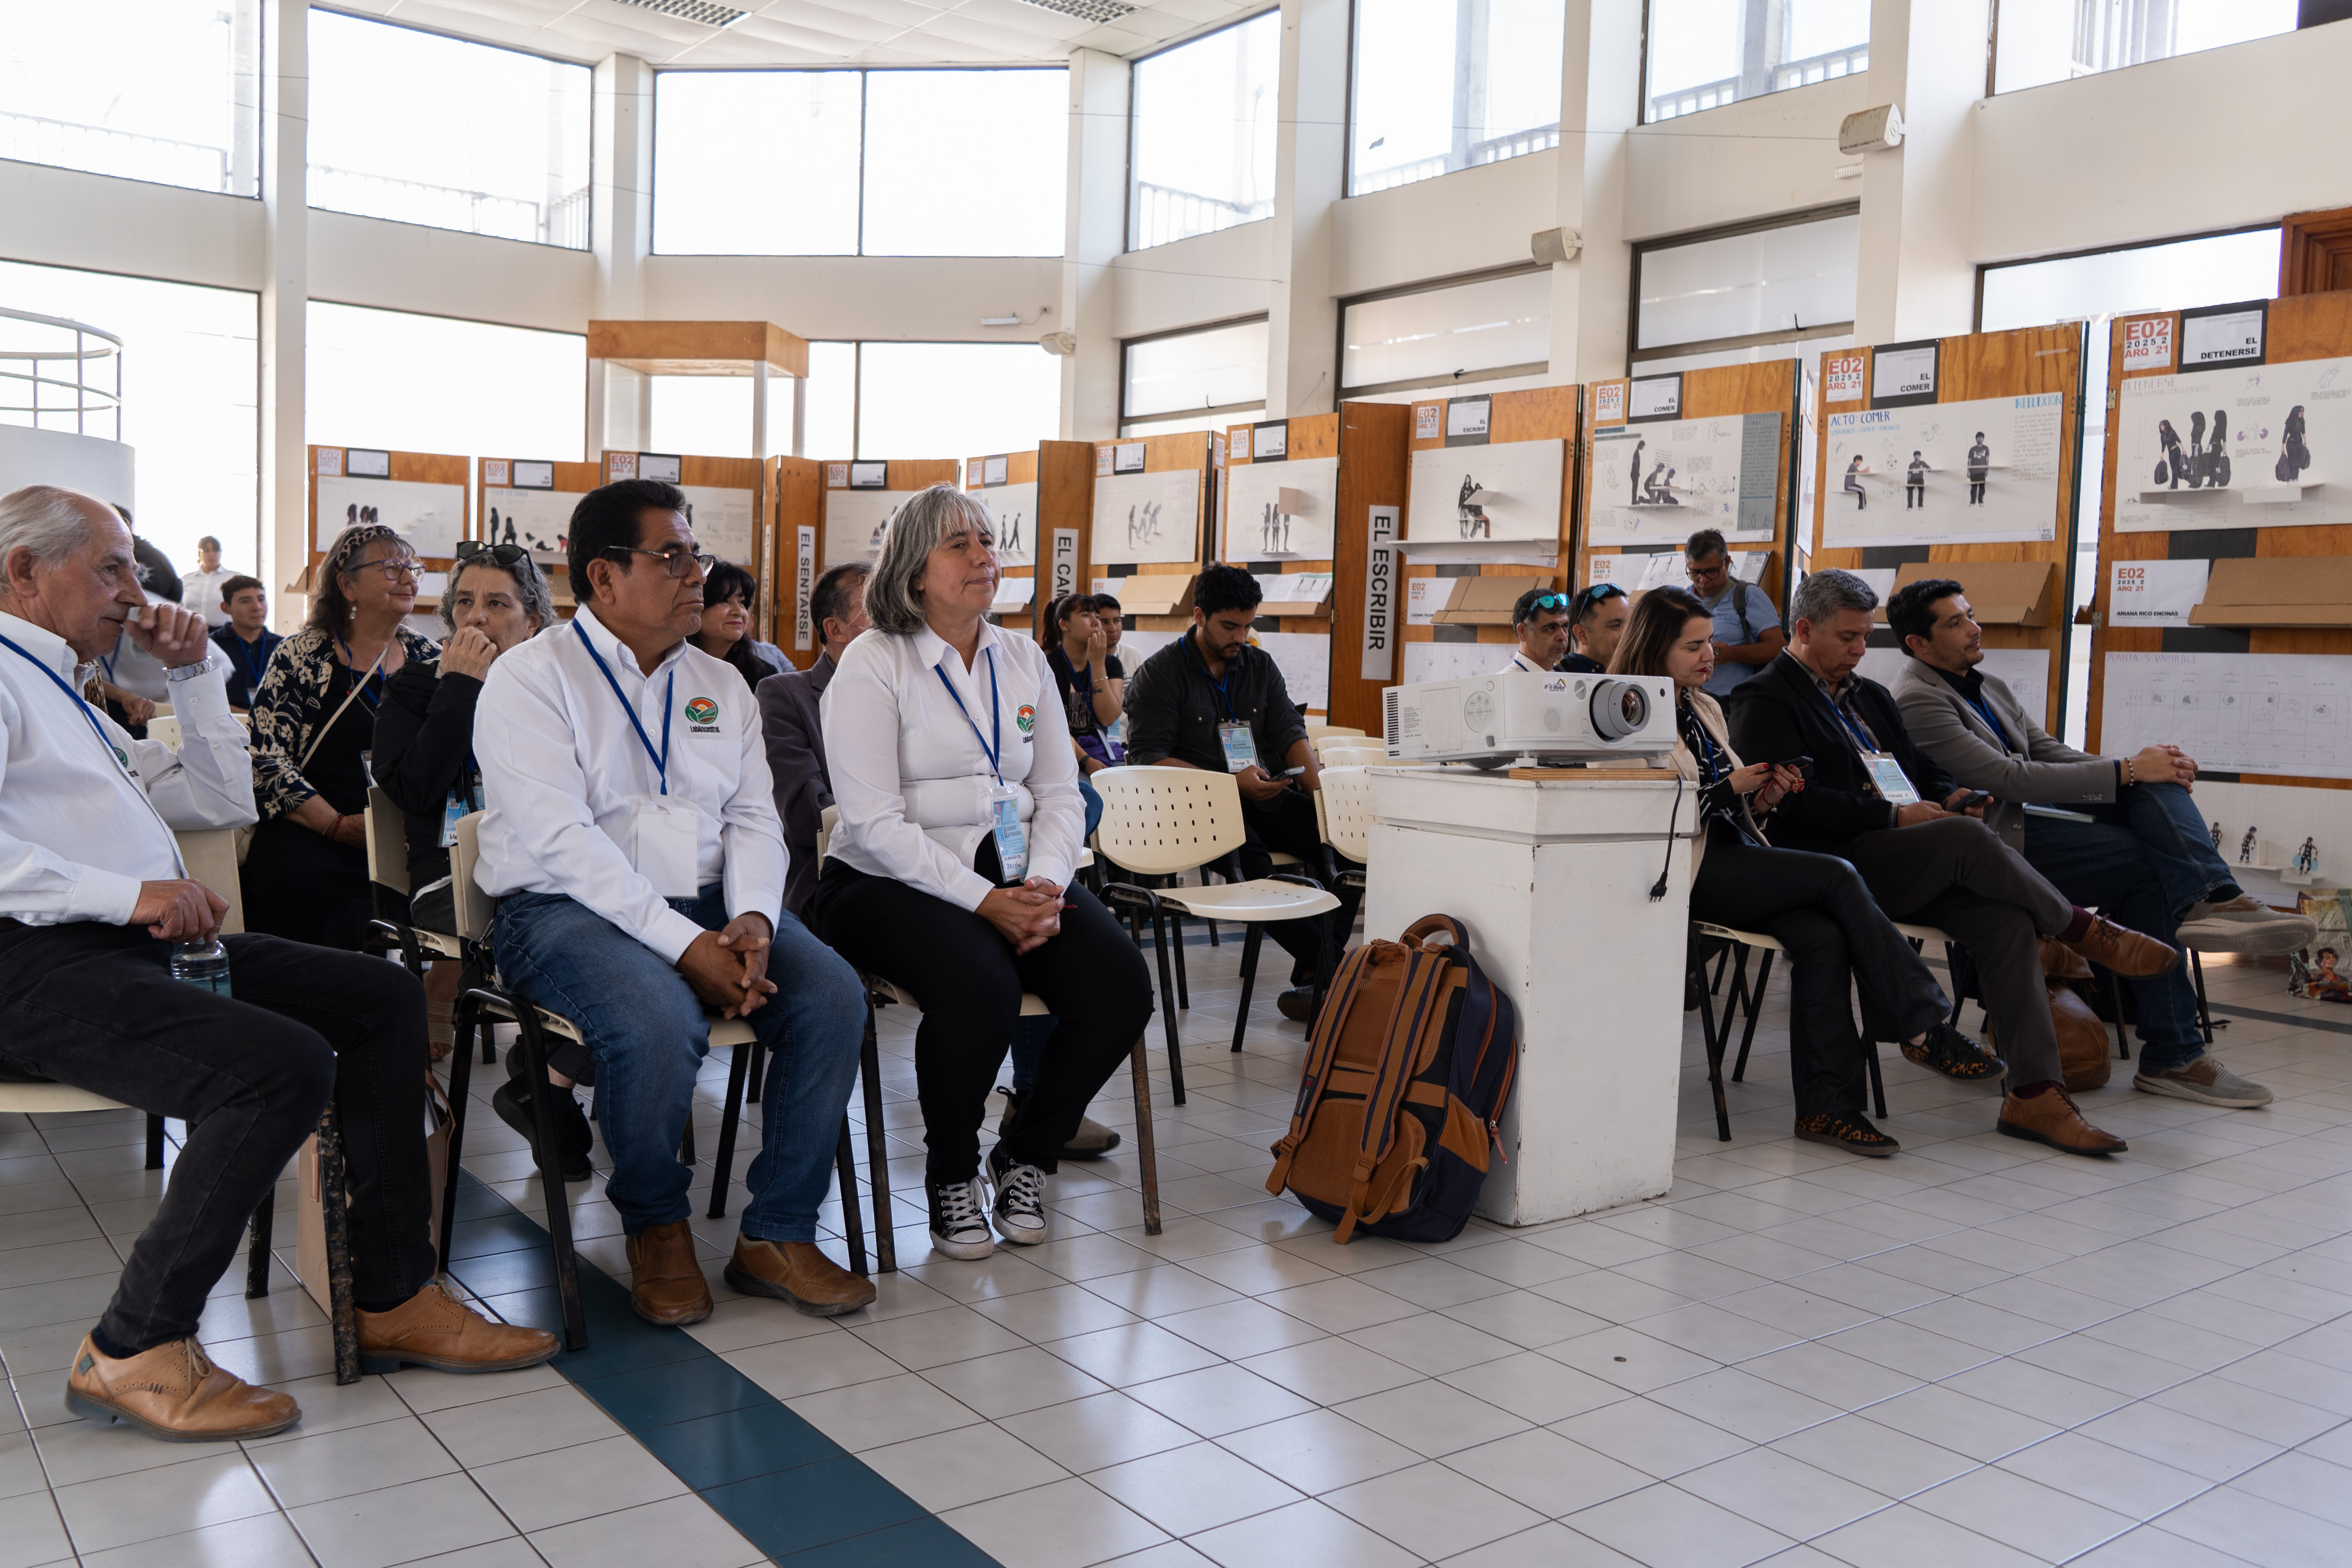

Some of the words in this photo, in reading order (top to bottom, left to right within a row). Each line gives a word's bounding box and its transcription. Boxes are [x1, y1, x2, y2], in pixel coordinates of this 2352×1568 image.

[2126, 319, 2169, 341] E02
[2127, 338, 2156, 348] 2025
[2125, 348, 2149, 358] ARQ
[2156, 344, 2168, 355] 21
[2201, 347, 2257, 359] DETENERSE
[1829, 358, 1862, 375] E02
[1827, 382, 1846, 390] ARQ
[1900, 383, 1930, 392] COMER
[1599, 386, 1621, 399] E02
[1419, 408, 1437, 419] E02
[1861, 411, 1890, 423] COMER
[1232, 432, 1247, 441] E02
[1098, 448, 1114, 458] E02
[612, 455, 634, 464] E02
[1375, 516, 1390, 542] EL
[801, 533, 810, 552] EL
[1058, 537, 1071, 558] EL
[1594, 560, 1611, 569] E02
[2118, 568, 2145, 578] E02
[798, 557, 810, 641] SENTARSE
[1368, 549, 1389, 651] ESCRIBIR
[2107, 653, 2138, 662] PLANTA
[690, 725, 720, 733] LabAncestral
